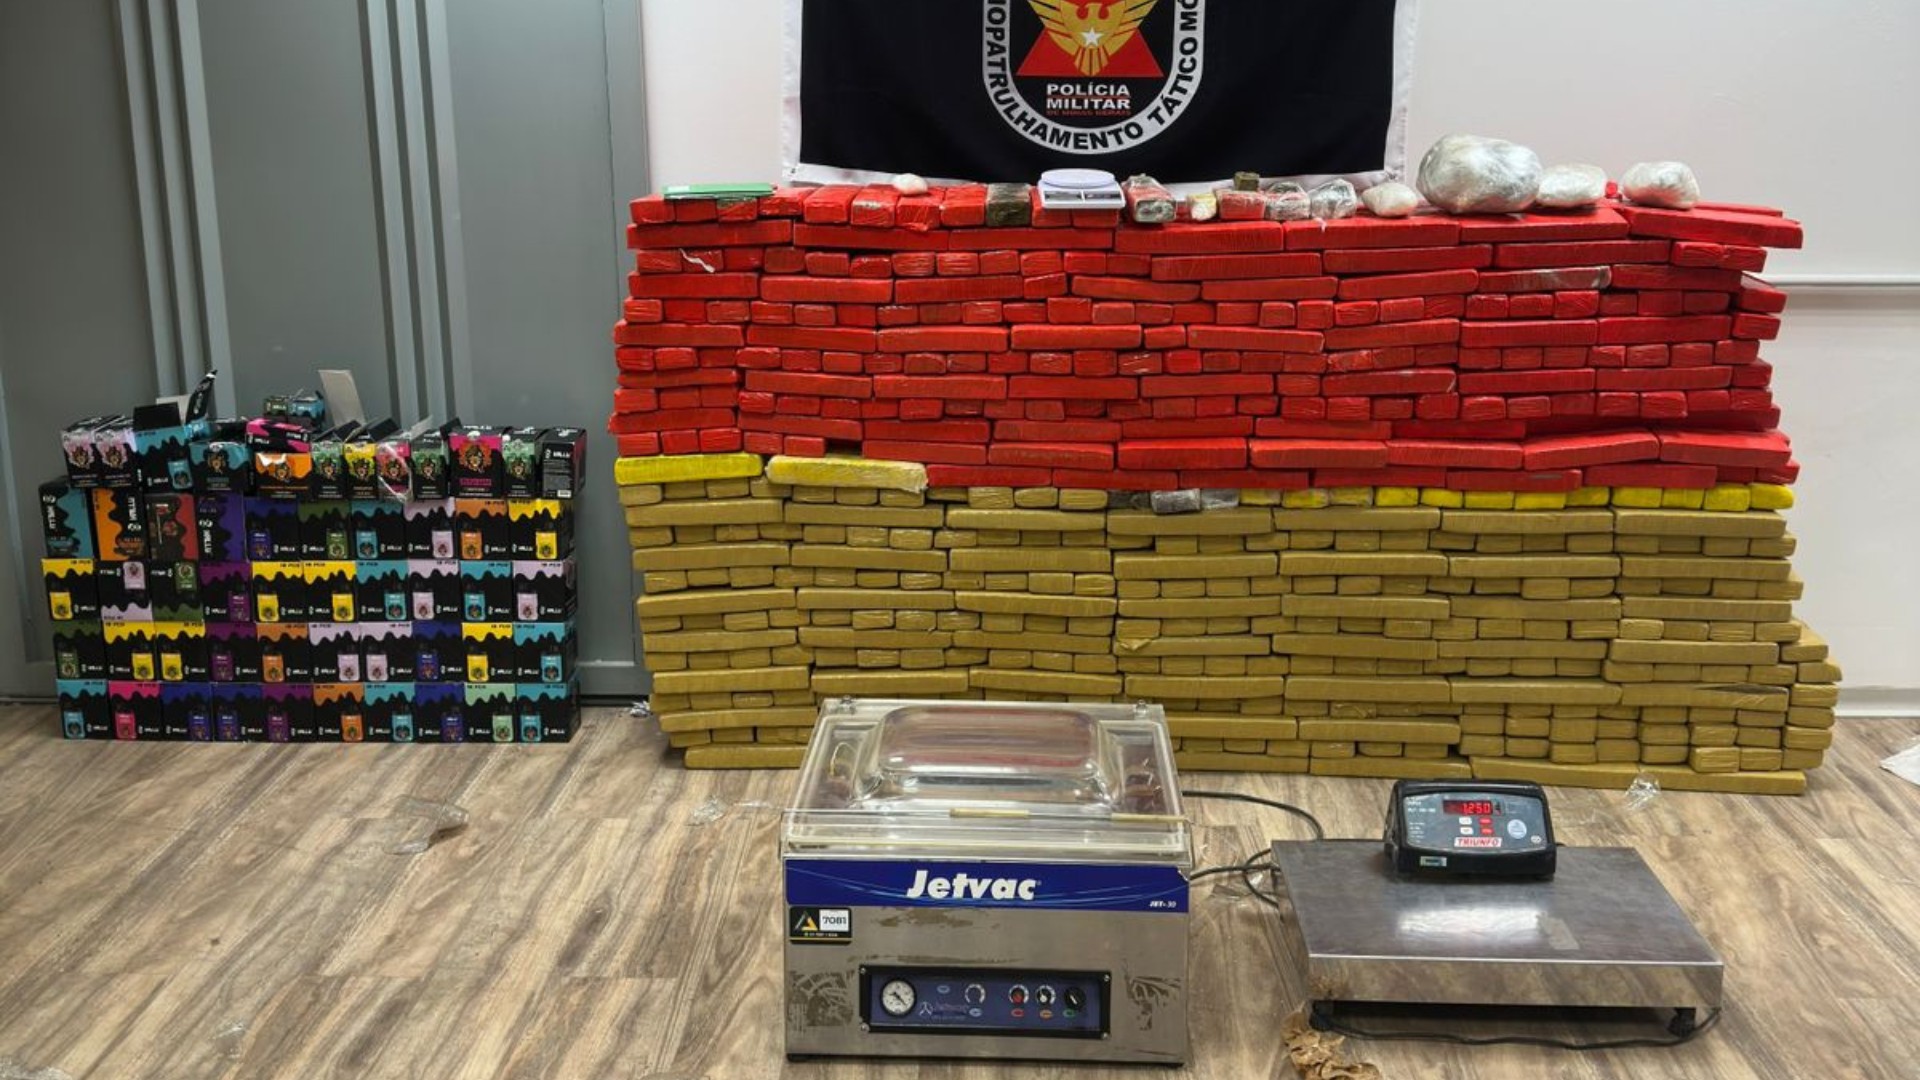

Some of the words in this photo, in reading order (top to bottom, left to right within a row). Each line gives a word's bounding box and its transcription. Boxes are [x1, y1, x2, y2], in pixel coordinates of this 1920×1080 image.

[1147, 37, 1198, 126] TÁTICO
[1046, 81, 1130, 96] POLÍCIA
[1046, 98, 1131, 110] MILITAR
[1457, 838, 1500, 847] TRIUNFO
[906, 869, 1037, 900] Jetvac
[822, 916, 847, 925] 7081
